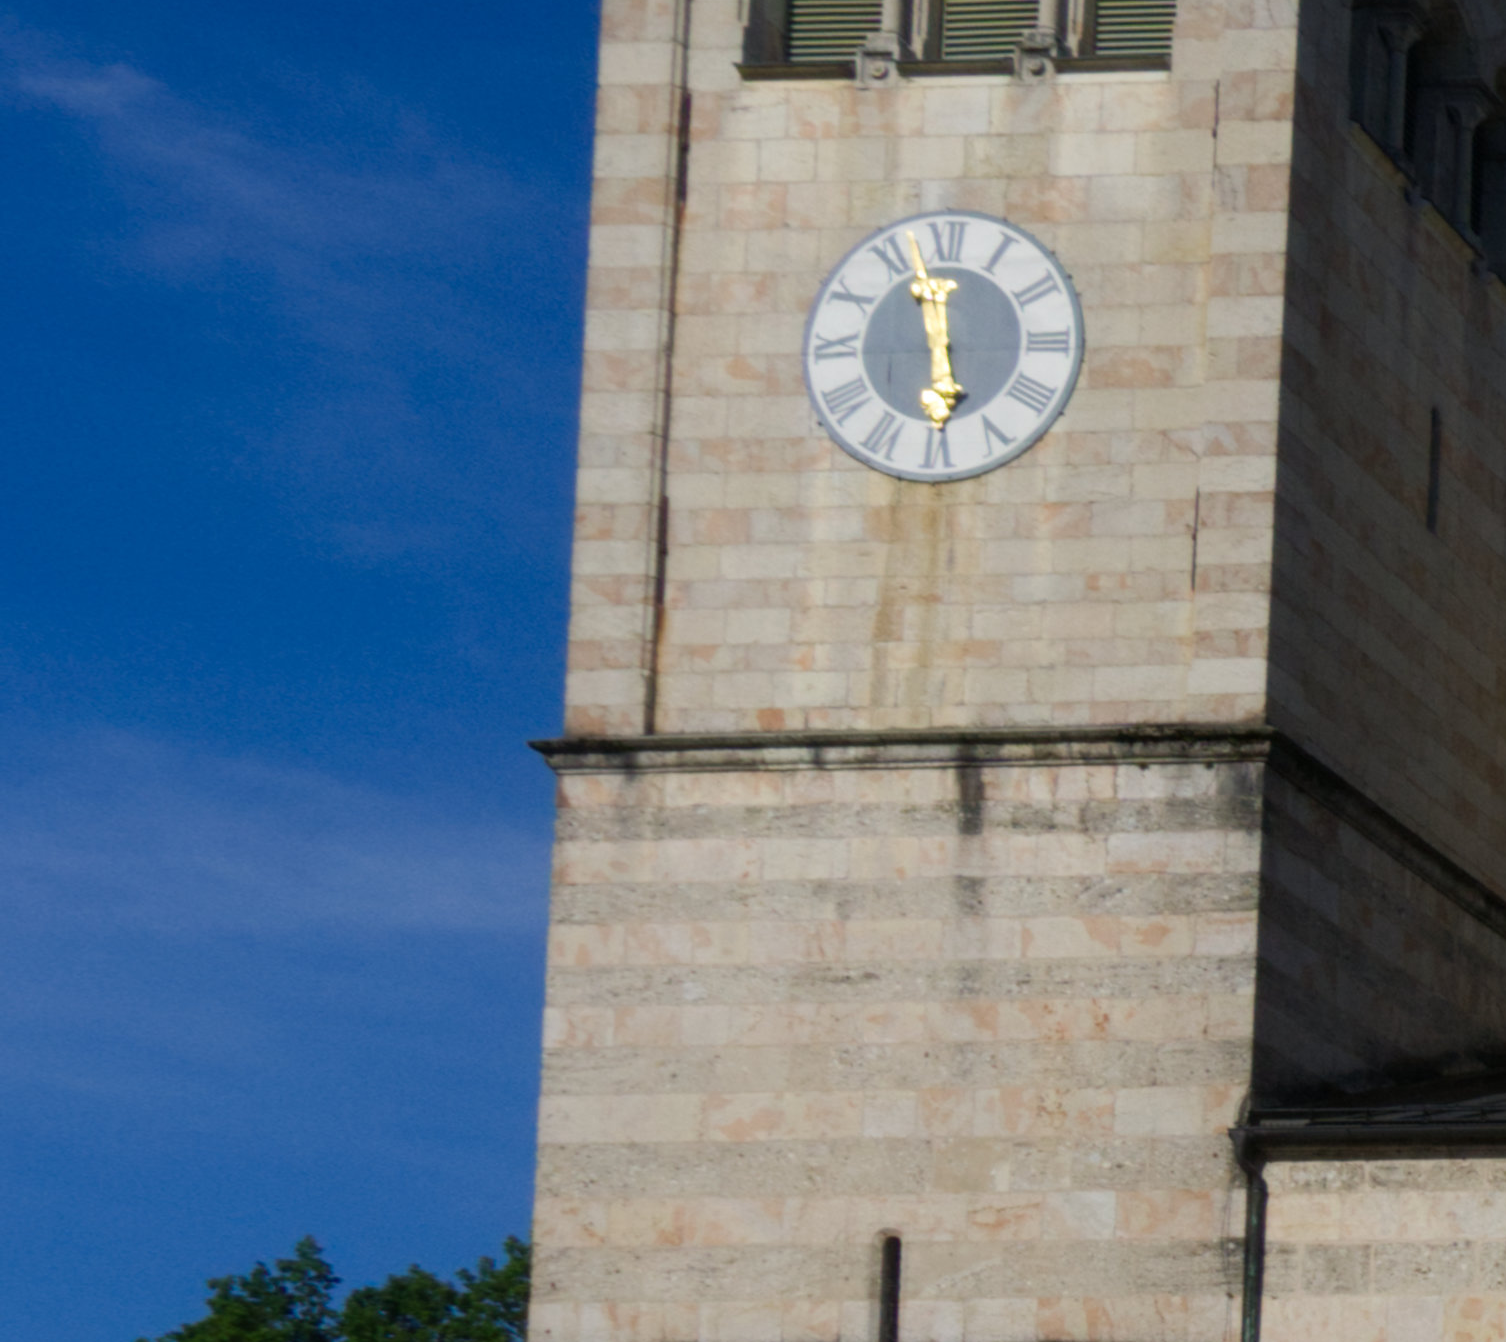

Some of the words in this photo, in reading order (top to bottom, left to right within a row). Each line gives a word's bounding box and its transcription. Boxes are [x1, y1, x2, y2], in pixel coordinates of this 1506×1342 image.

[867, 232, 914, 283] XI
[926, 221, 969, 263] XII
[982, 231, 1021, 276] I
[827, 275, 877, 315] X
[1012, 268, 1062, 311] II
[814, 330, 860, 364] IX
[1026, 325, 1070, 357] III
[820, 374, 872, 427] VIII
[1005, 373, 1057, 417] IIII
[858, 410, 905, 462] VII
[918, 425, 957, 469] VI
[981, 413, 1017, 459] V
